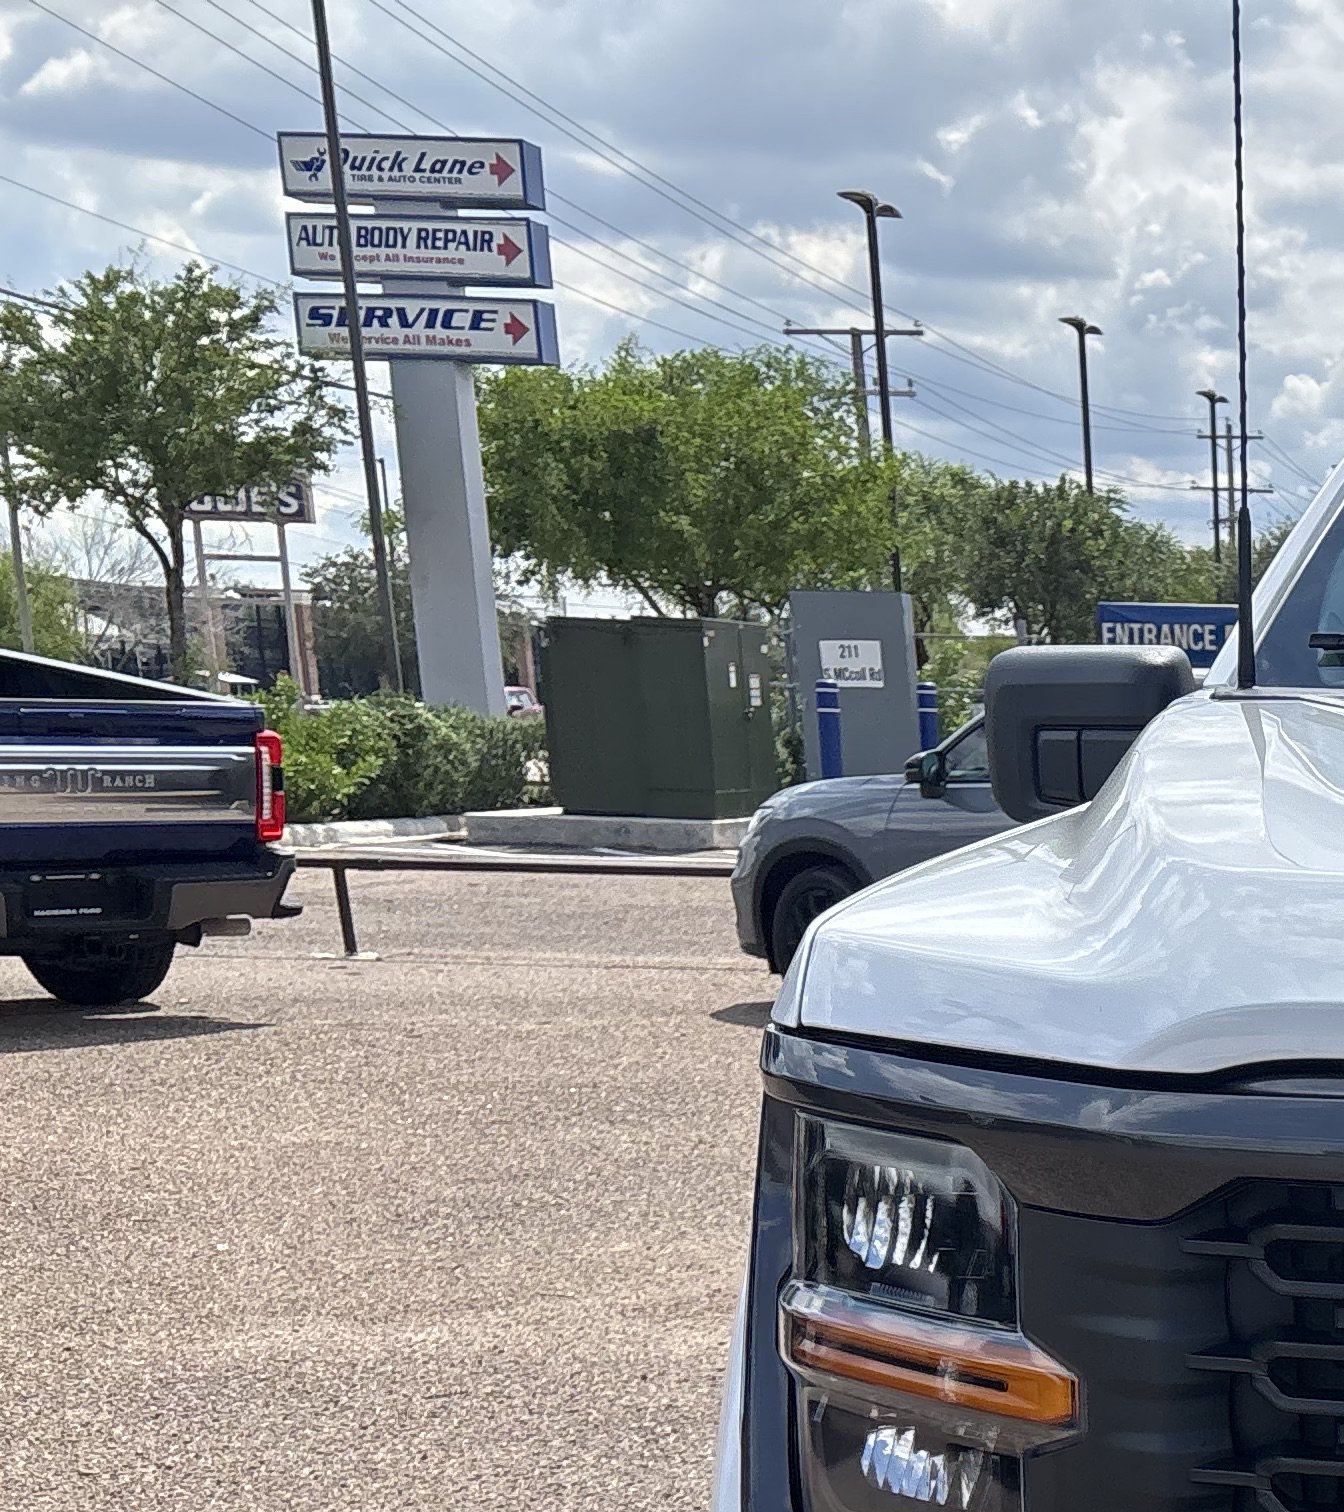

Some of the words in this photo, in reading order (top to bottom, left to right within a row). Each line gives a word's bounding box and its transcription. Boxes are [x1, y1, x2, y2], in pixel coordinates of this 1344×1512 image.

[412, 151, 485, 176] Lane
[351, 173, 374, 182] TIRE
[377, 174, 385, 182] &
[387, 174, 416, 184] AUTO
[419, 175, 462, 185] CENTER
[296, 224, 339, 247] AUT
[355, 225, 412, 249] BODY
[416, 228, 494, 252] REPAIR
[317, 252, 336, 261] We
[354, 252, 380, 264] cept
[384, 253, 400, 262] All
[403, 253, 465, 265] Insurance
[328, 333, 349, 344] We
[360, 333, 399, 345] ervice
[402, 334, 421, 345] All
[425, 335, 472, 347] Makes
[1101, 622, 1217, 650] ENTRANCE
[838, 644, 859, 658] 211
[2, 775, 41, 788] ING
[102, 774, 156, 788] RANCH
